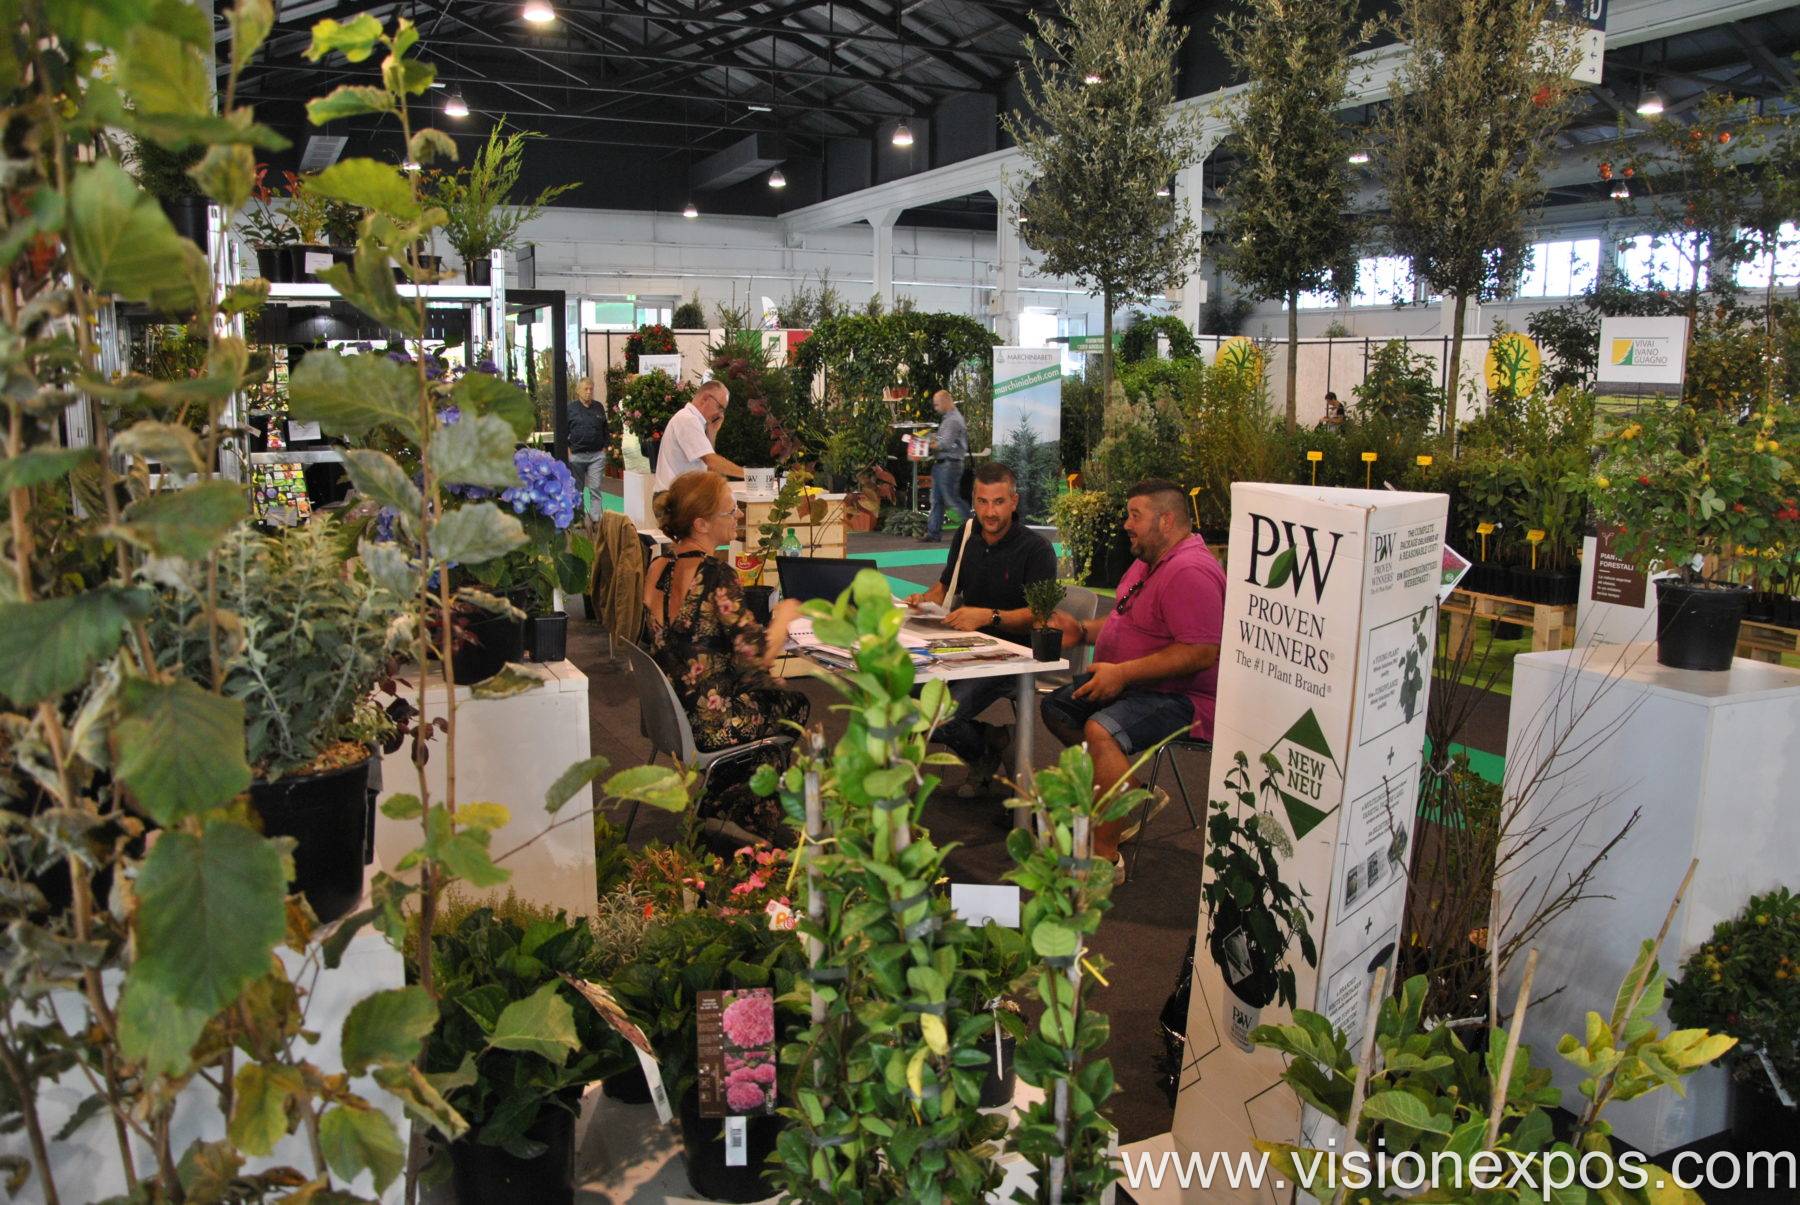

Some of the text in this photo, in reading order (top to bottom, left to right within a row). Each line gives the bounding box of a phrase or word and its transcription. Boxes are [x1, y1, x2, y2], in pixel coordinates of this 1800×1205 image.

[994, 368, 1059, 393] marchiniabeti.com
[1244, 512, 1344, 605] PW
[1599, 561, 1634, 571] FORESTALI
[1600, 552, 1622, 561] PIAN
[1248, 593, 1326, 640] PROVEN
[1236, 649, 1252, 668] The
[1253, 658, 1265, 674] #1
[1267, 662, 1292, 685] Plant
[1288, 748, 1326, 780] NEW
[1287, 769, 1322, 800] NEU
